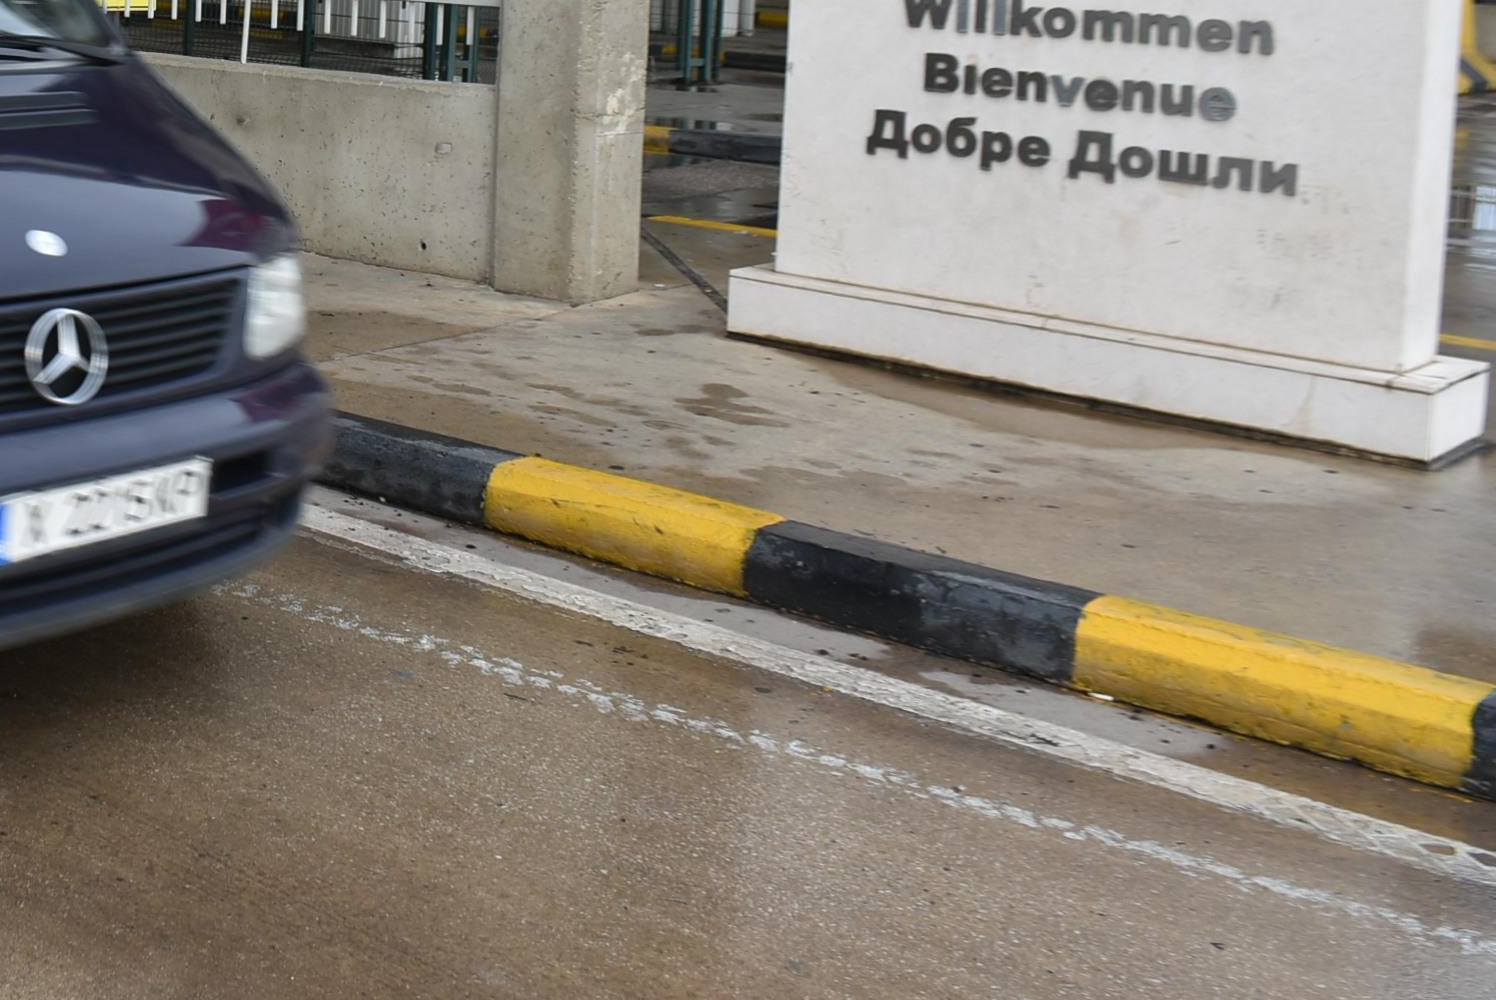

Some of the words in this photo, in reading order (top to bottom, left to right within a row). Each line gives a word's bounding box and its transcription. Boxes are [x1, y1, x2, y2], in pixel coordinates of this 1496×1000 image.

[923, 52, 1237, 122] Bienvenue
[866, 109, 1052, 171] Добре
[1068, 129, 1300, 198] Дошли
